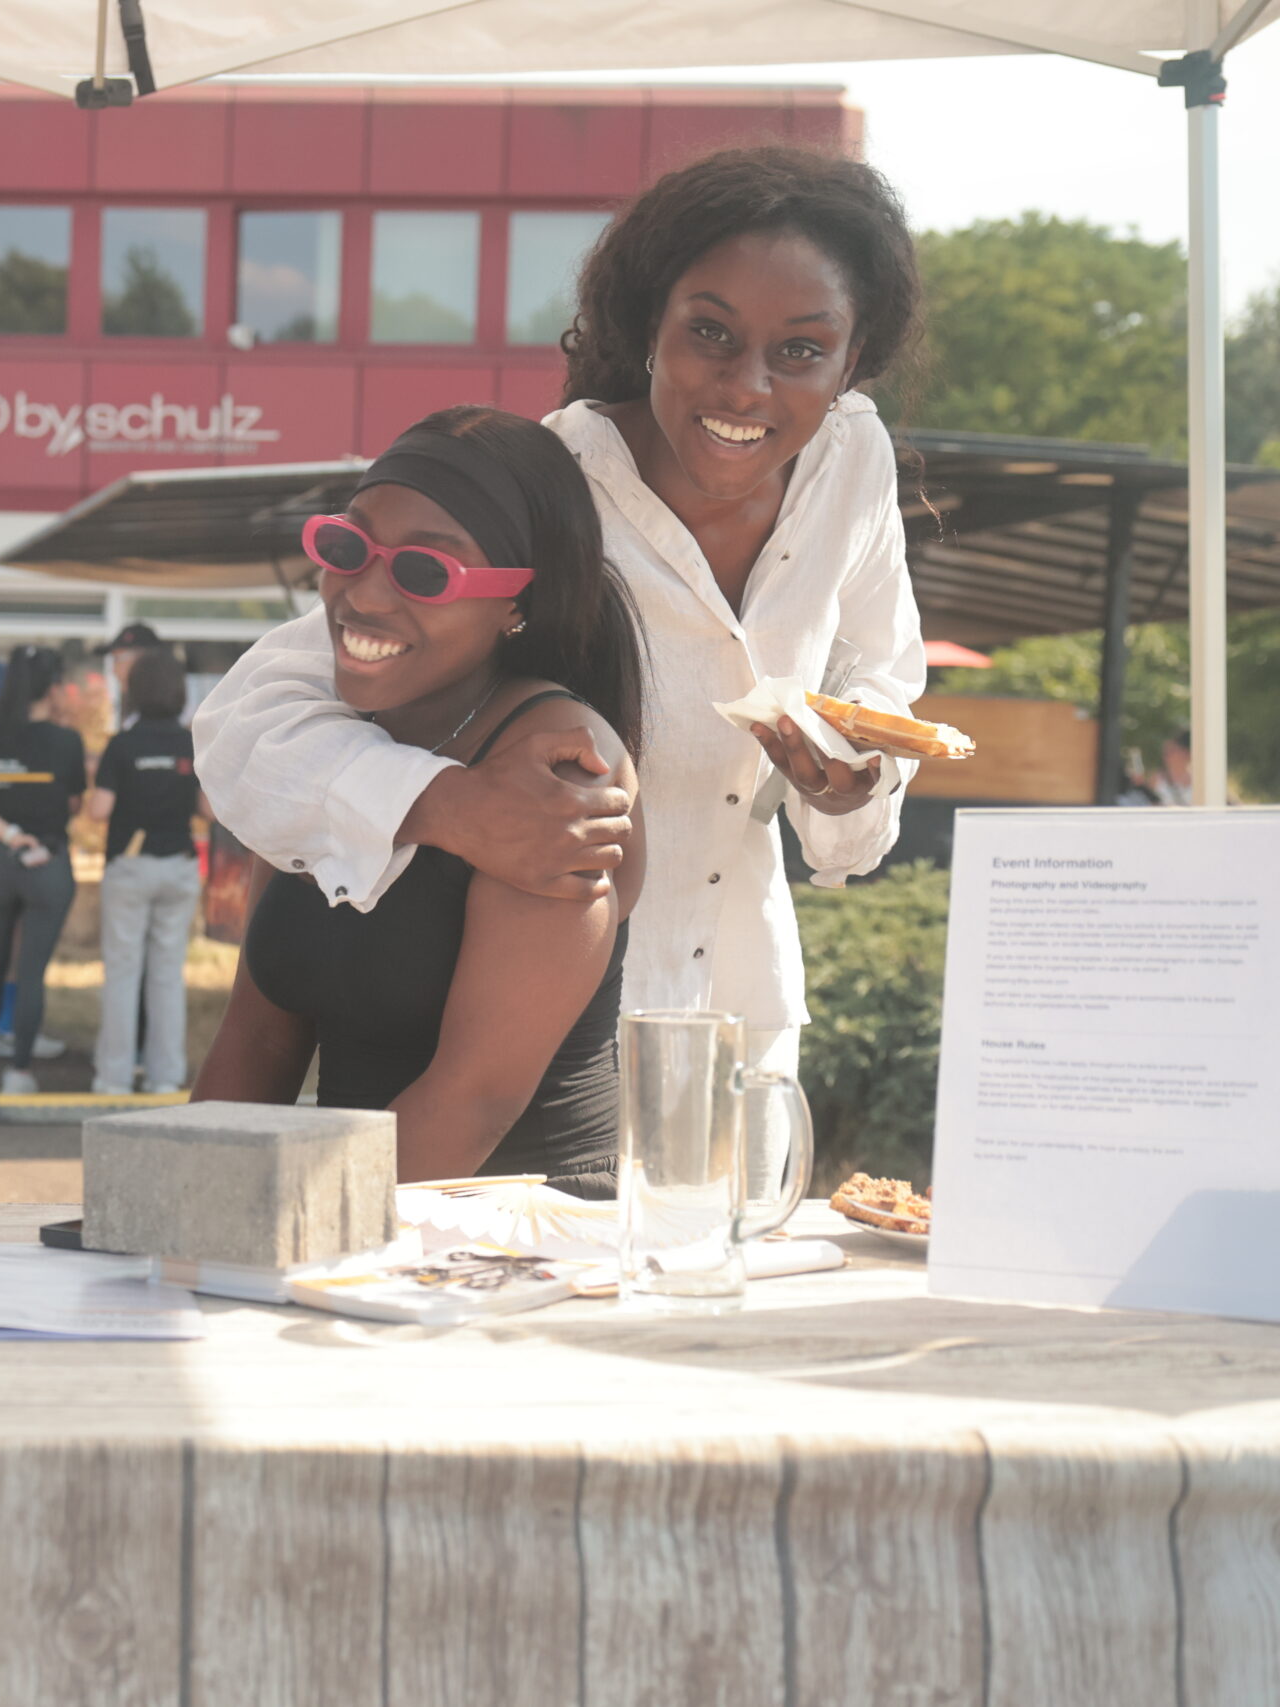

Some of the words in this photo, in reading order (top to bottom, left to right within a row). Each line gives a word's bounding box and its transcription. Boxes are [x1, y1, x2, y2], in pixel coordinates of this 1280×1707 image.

[992, 857, 1030, 869] Event
[1034, 857, 1113, 870] Information
[991, 879, 1056, 892] Photography
[1059, 880, 1079, 890] and
[1081, 880, 1148, 892] Videography
[981, 1039, 1014, 1049] House
[1016, 1039, 1047, 1050] Rules
